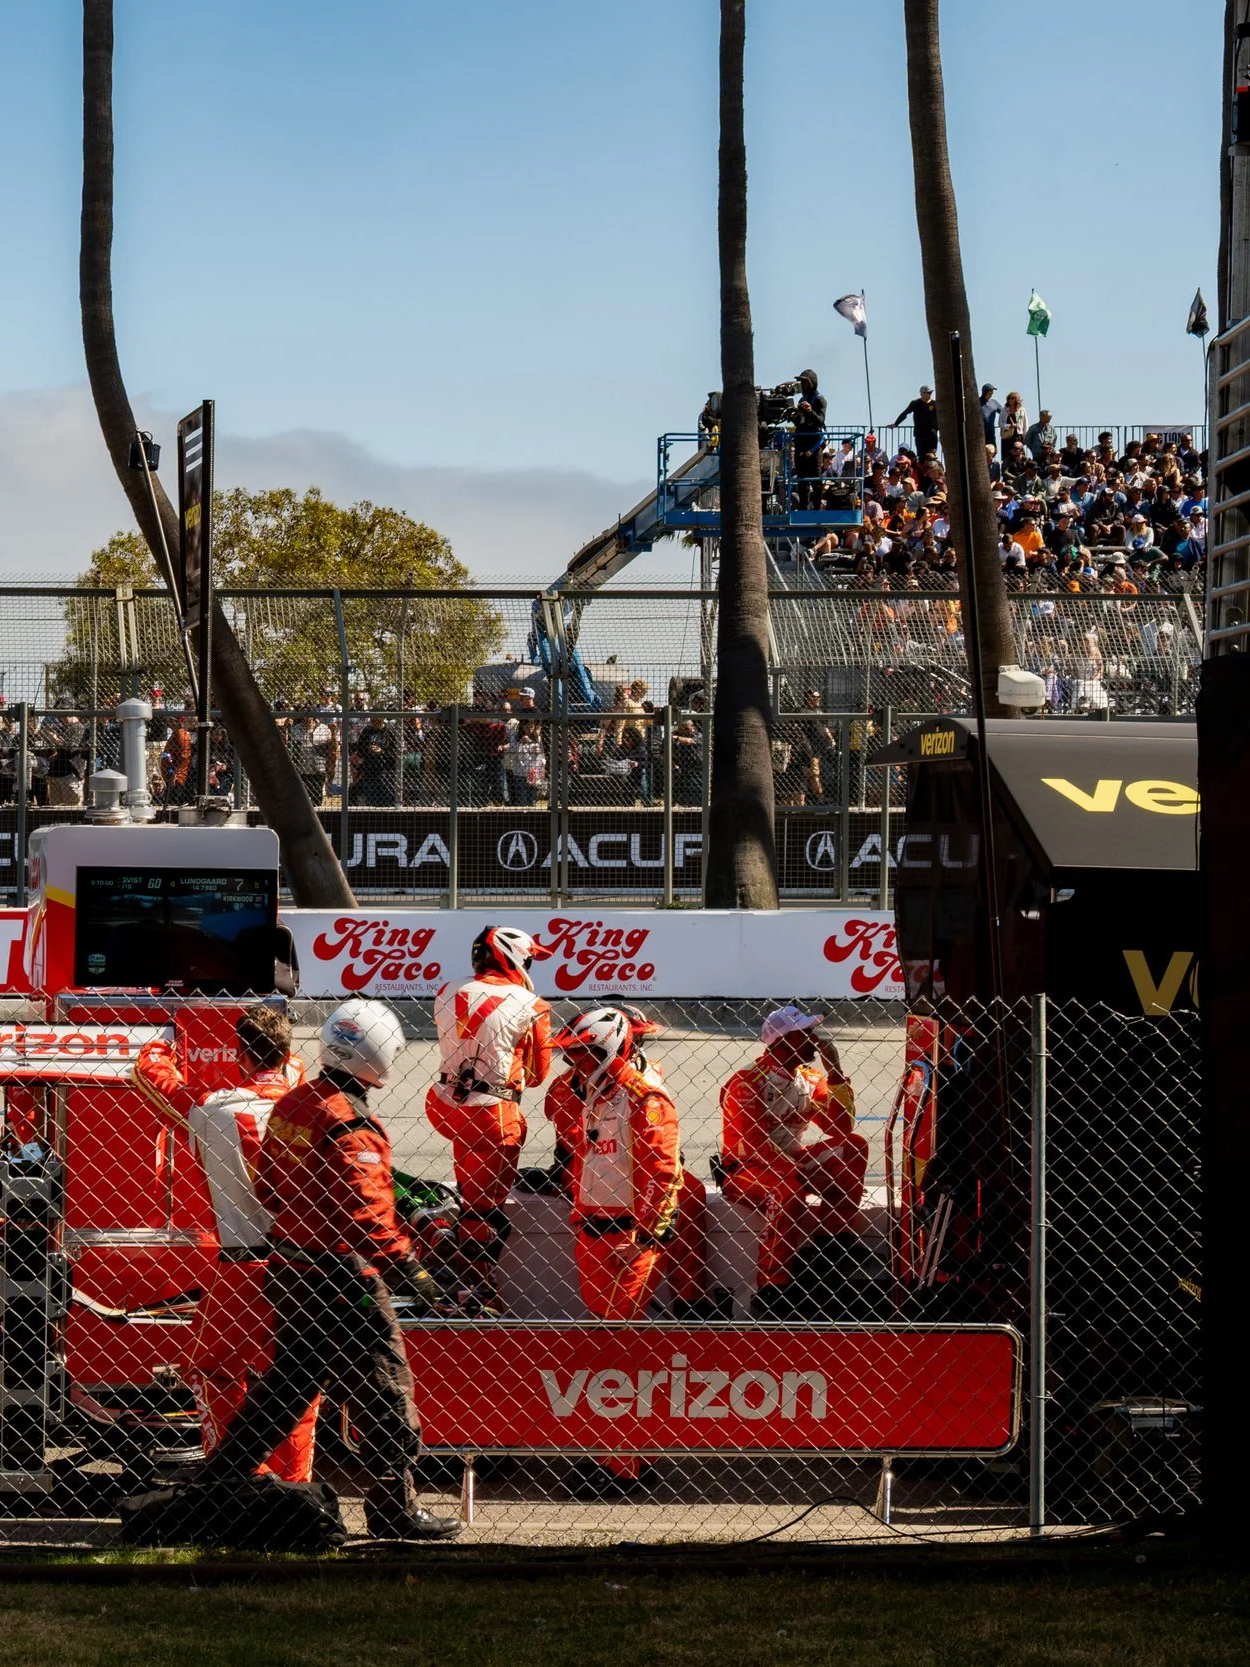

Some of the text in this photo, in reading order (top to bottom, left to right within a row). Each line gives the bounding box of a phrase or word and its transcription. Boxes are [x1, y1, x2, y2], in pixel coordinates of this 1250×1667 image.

[921, 726, 954, 755] verizon
[313, 917, 437, 961] King
[531, 917, 650, 961] King
[341, 949, 442, 991] Taco
[375, 983, 424, 991] RESTAURANTS,
[554, 949, 655, 991] Taco
[589, 983, 638, 992] RESTAURANTS,
[541, 1353, 829, 1420] verizon
